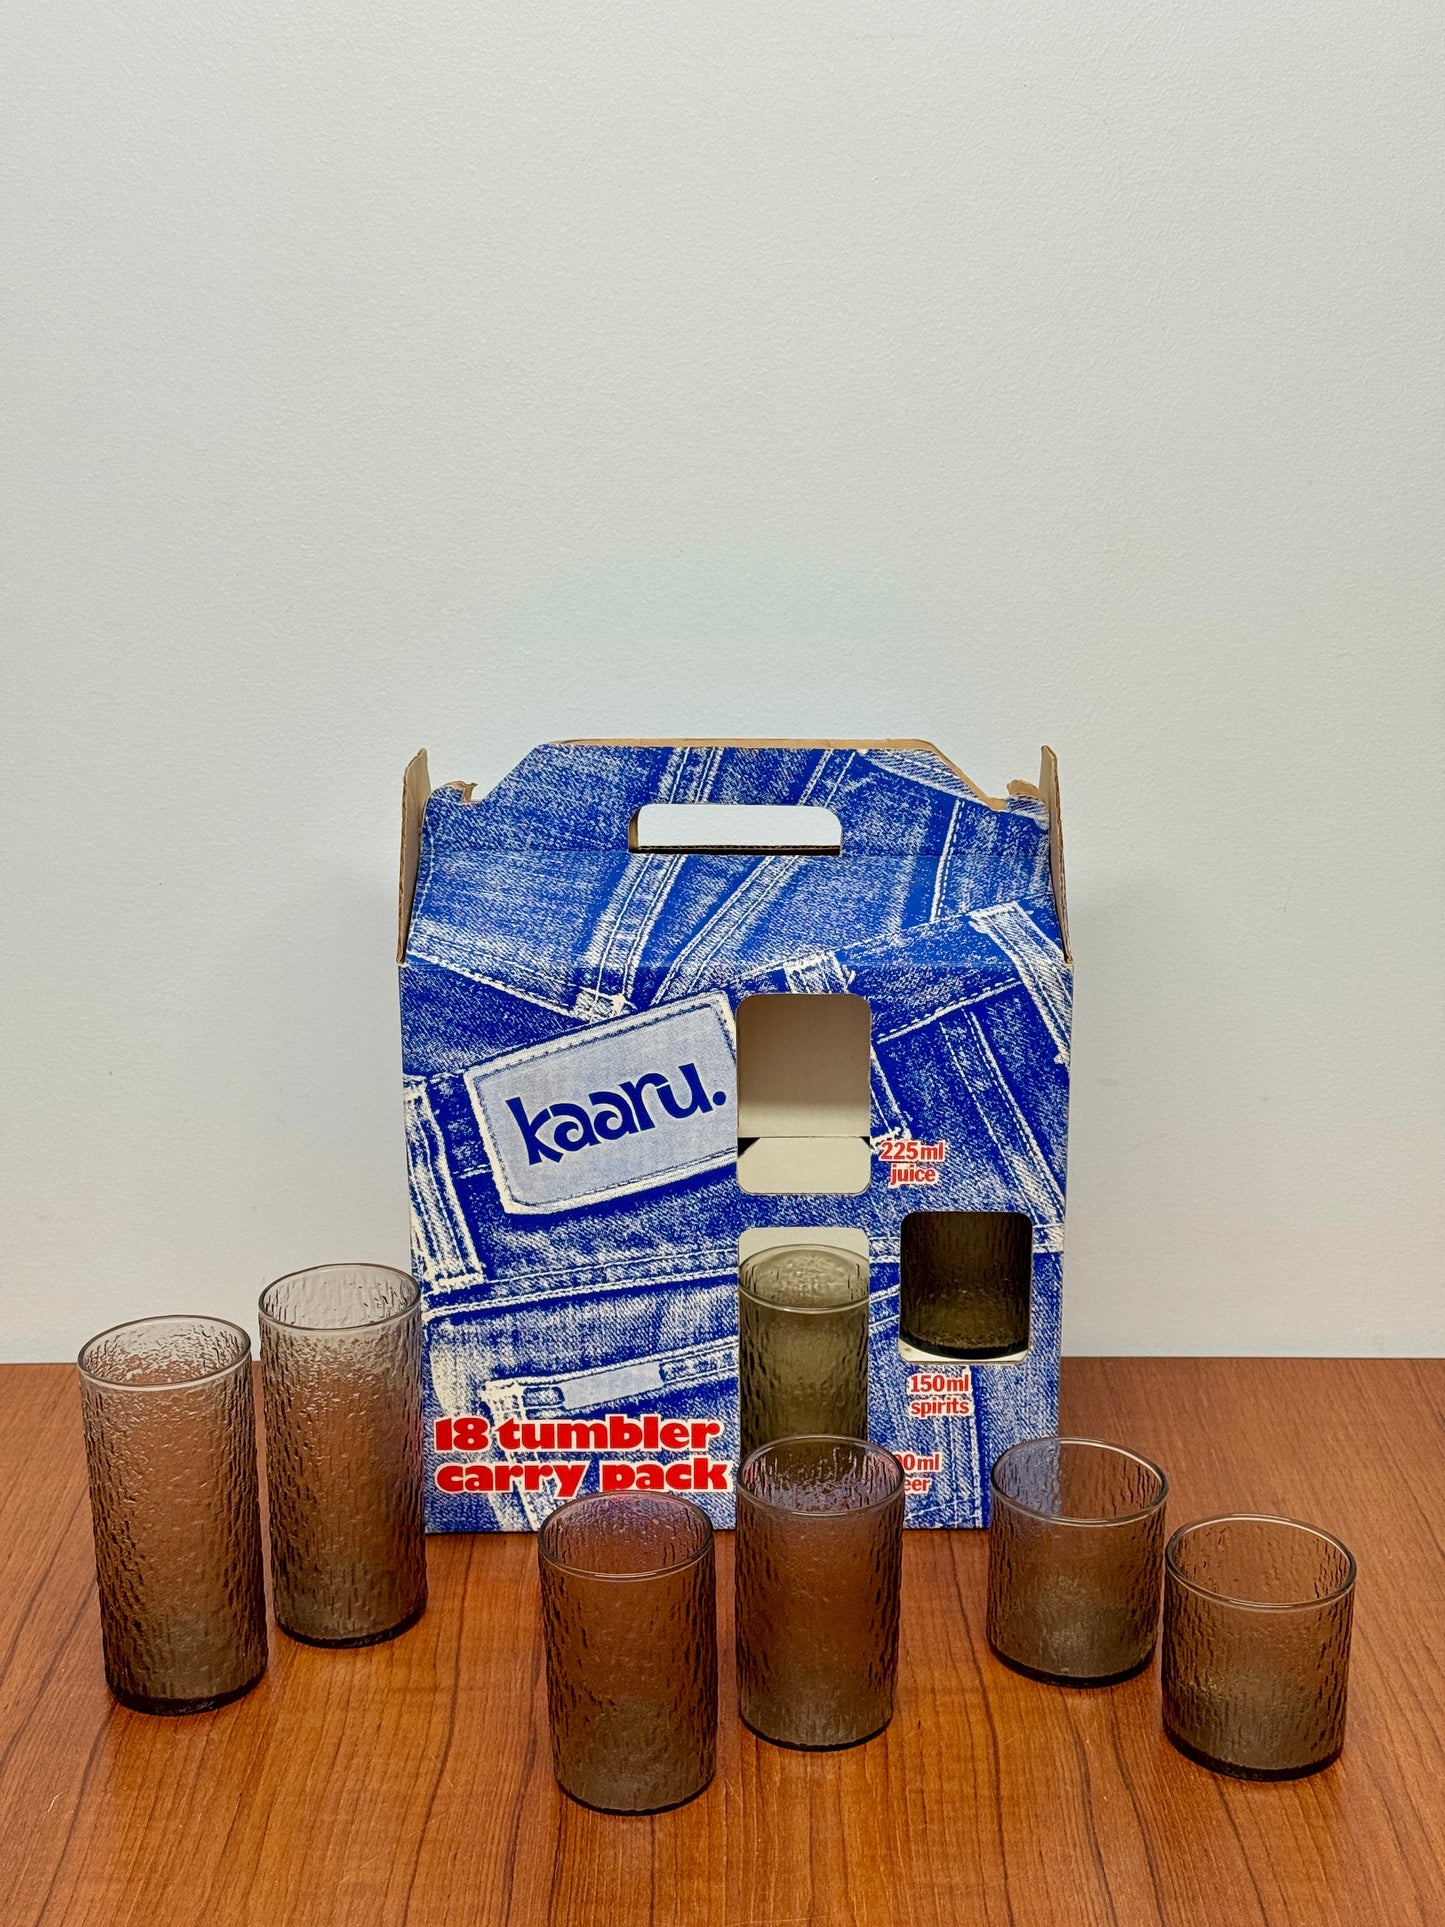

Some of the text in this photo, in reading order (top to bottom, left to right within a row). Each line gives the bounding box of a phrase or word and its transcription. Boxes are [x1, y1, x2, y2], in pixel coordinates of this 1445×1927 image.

[505, 1062, 727, 1166] kaaru.
[890, 1163, 936, 1186] juice
[911, 1397, 970, 1417] spirits
[435, 1415, 721, 1451] 18 tumbler
[436, 1457, 728, 1498] carry pack
[904, 1478, 931, 1492] eer
